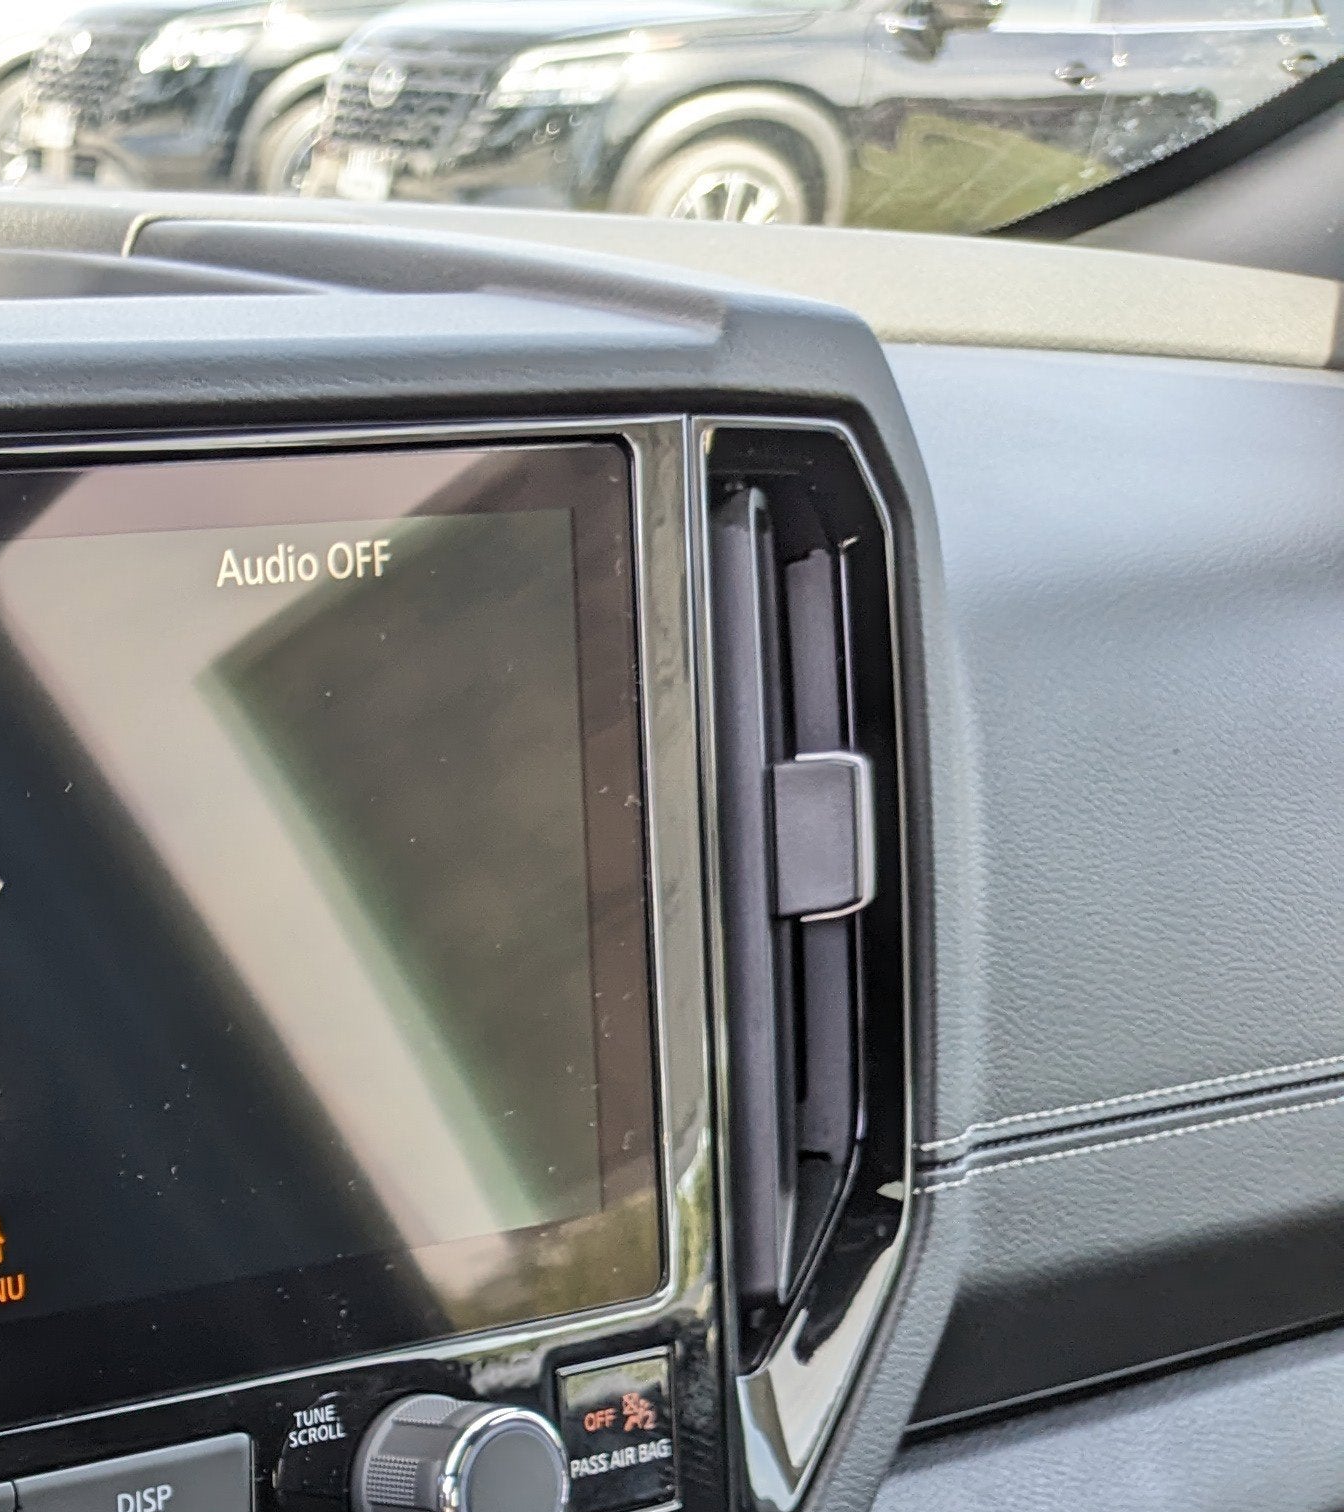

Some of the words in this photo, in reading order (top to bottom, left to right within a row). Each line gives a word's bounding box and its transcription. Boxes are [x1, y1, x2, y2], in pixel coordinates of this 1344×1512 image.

[214, 540, 318, 588] Audio
[324, 536, 392, 582] OFF
[292, 1404, 338, 1429] TUNE
[584, 1407, 616, 1433] OFF
[288, 1422, 348, 1448] SCROLL
[570, 1451, 611, 1479] PASS
[610, 1446, 639, 1471] AIR
[638, 1438, 673, 1464] BAG
